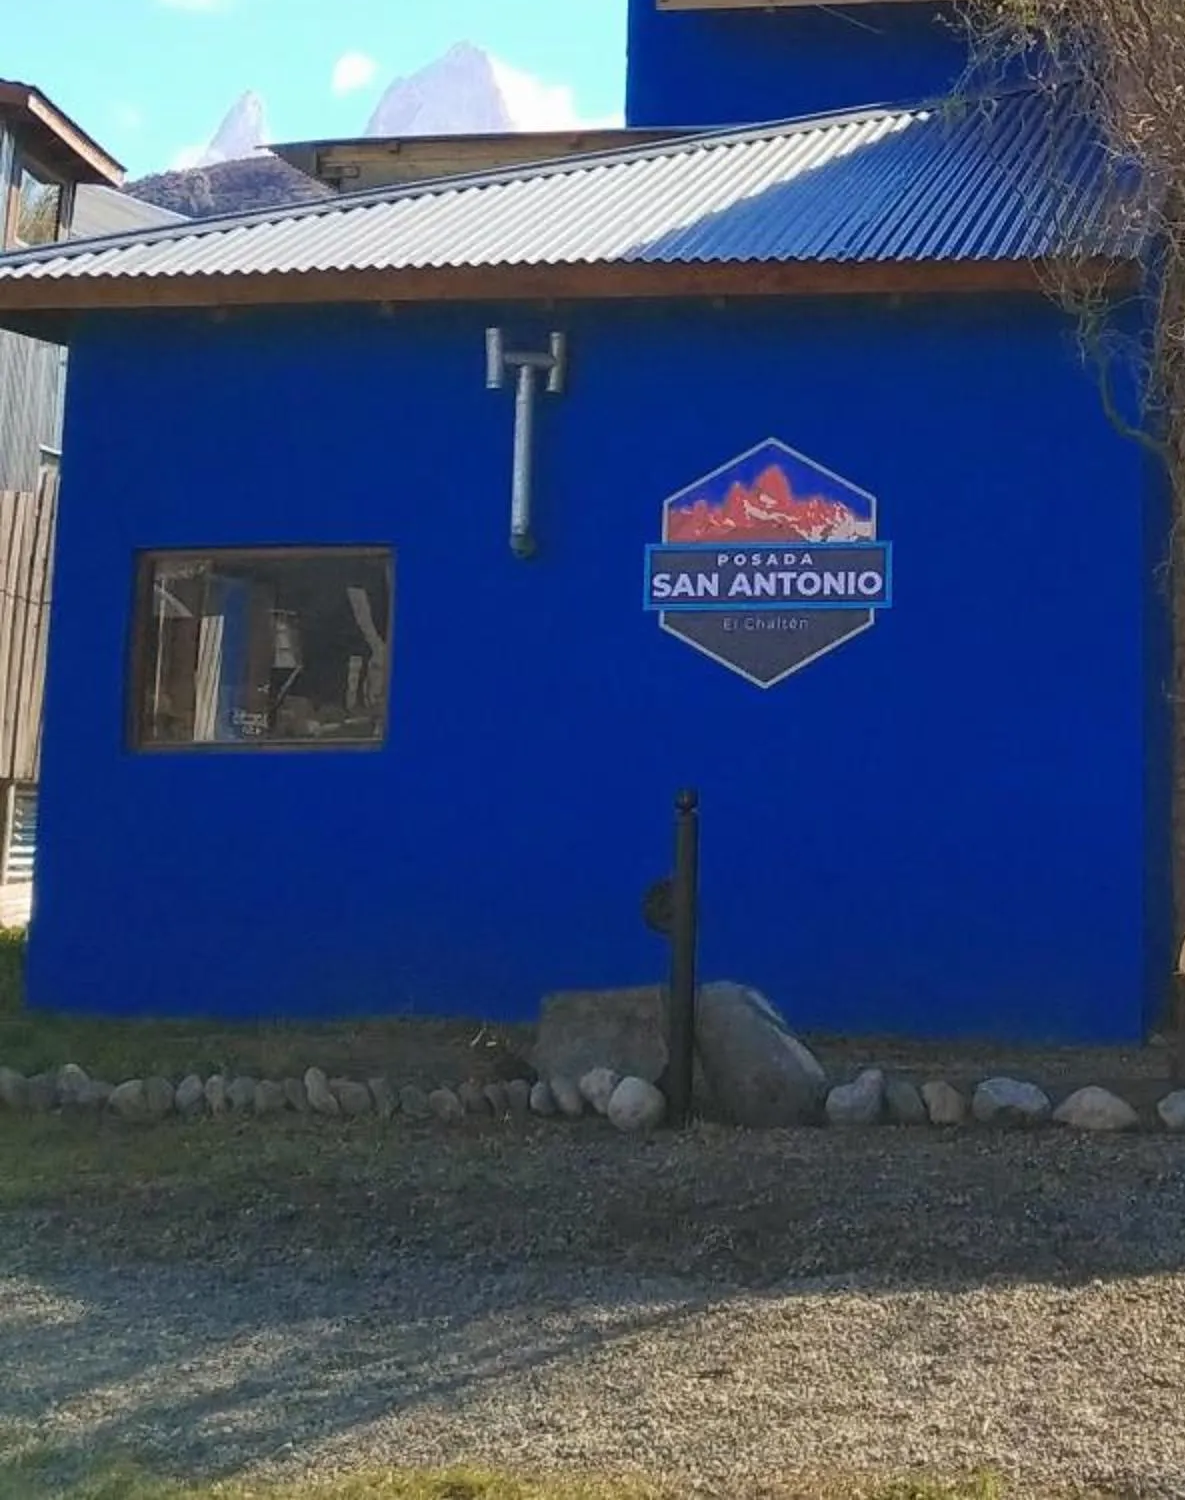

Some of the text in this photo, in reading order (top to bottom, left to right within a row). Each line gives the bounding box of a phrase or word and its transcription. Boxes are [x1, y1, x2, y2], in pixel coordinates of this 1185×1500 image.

[717, 553, 814, 566] POSADA
[653, 571, 882, 597] SAN ANTONIO
[723, 618, 738, 631] El
